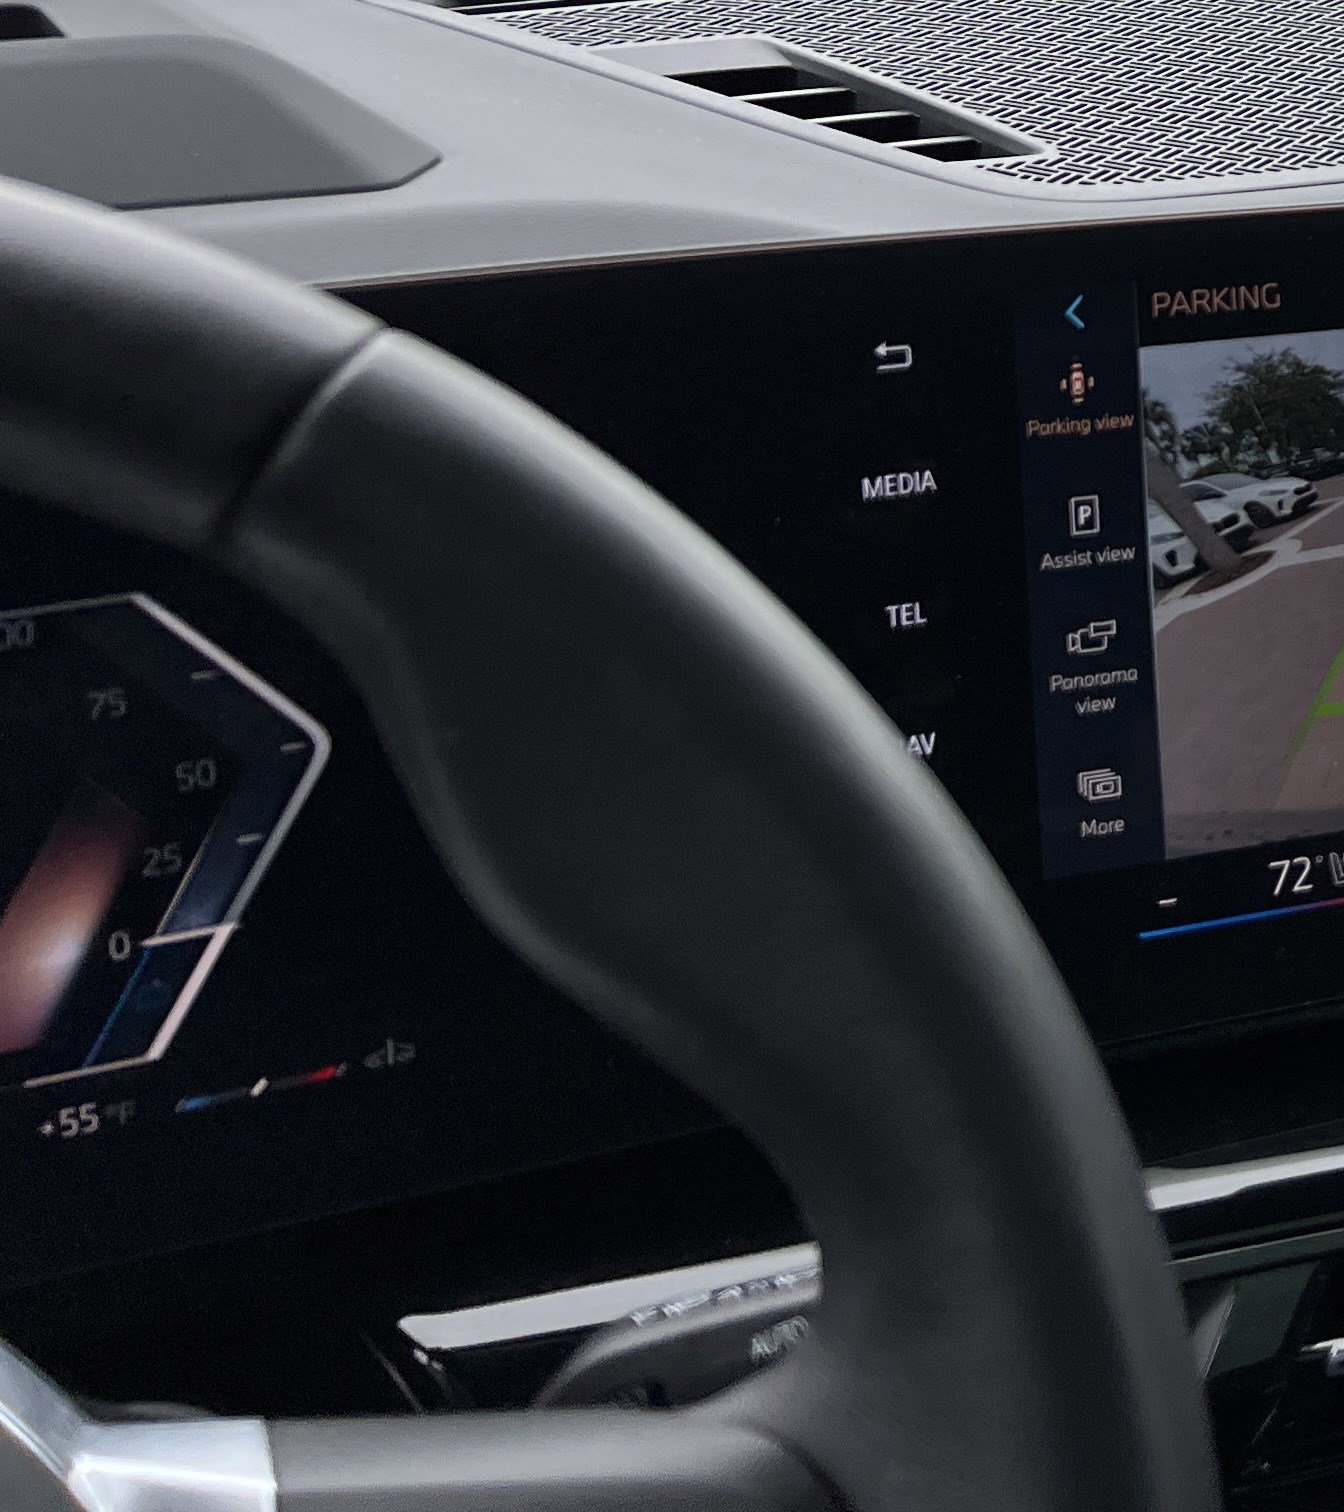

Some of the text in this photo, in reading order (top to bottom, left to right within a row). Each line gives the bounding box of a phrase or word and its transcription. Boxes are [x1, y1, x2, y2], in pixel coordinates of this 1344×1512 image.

[1151, 282, 1282, 318] PARKING
[1026, 413, 1135, 438] Parking view
[861, 469, 938, 501] MEDIA
[1040, 545, 1136, 570] Assist view
[884, 602, 928, 628] TEL
[1050, 667, 1139, 692] Panorama
[88, 687, 128, 720] 75
[1074, 695, 1117, 715] view
[906, 731, 936, 758] AV
[175, 758, 217, 792] 50
[1081, 817, 1126, 838] More
[142, 841, 183, 877] 25
[108, 929, 131, 962] 0
